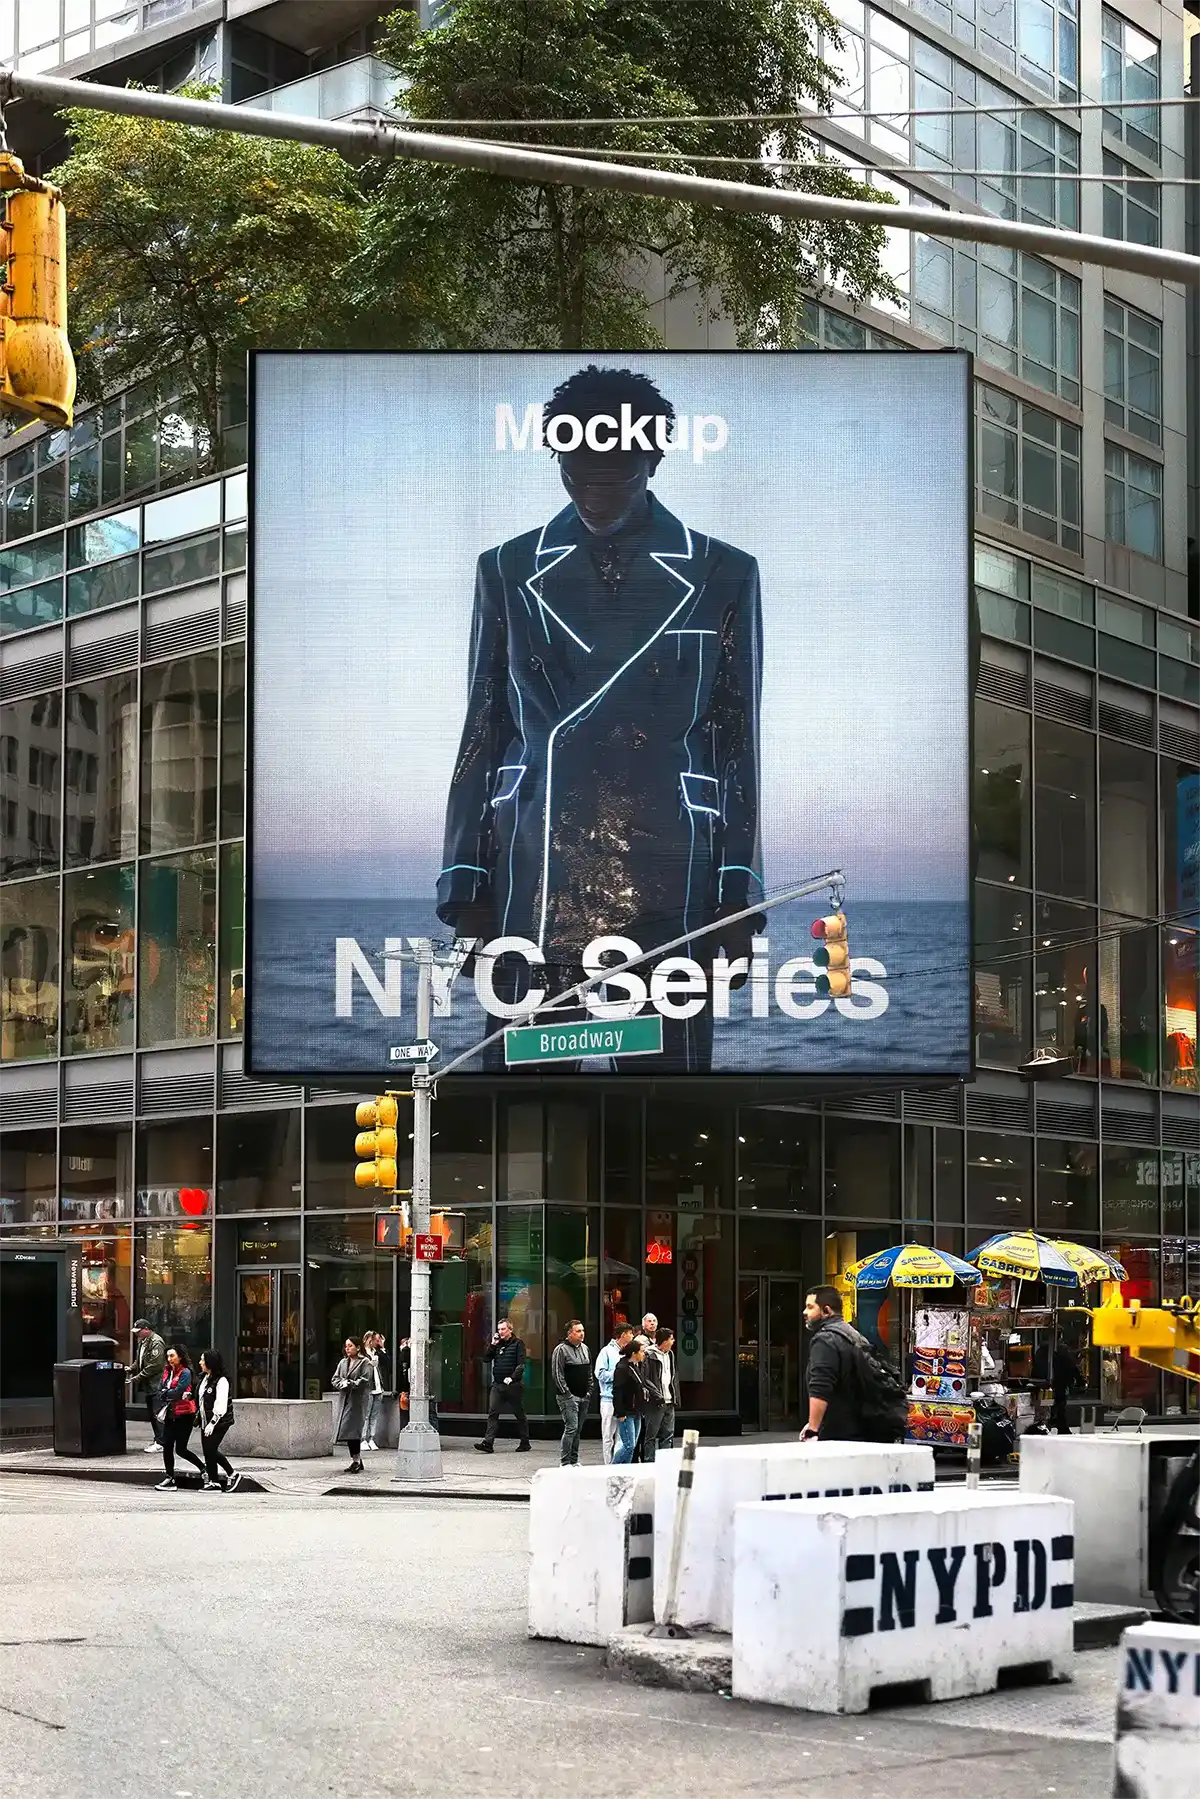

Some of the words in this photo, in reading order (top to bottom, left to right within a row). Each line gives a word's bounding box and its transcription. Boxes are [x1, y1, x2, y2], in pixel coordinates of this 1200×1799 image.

[495, 402, 730, 465] Mockup
[335, 936, 546, 1019] NYC
[582, 936, 890, 1020] Series
[395, 1047, 411, 1059] ONE
[417, 1045, 434, 1057] WAY
[540, 1029, 623, 1053] Broadway
[420, 1243, 439, 1252] WRONG
[423, 1251, 435, 1259] WAY
[981, 1257, 1037, 1279] SABRETT
[894, 1275, 952, 1285] SABRETT
[877, 1539, 1047, 1631] NYPD
[1125, 1648, 1200, 1694] NY
